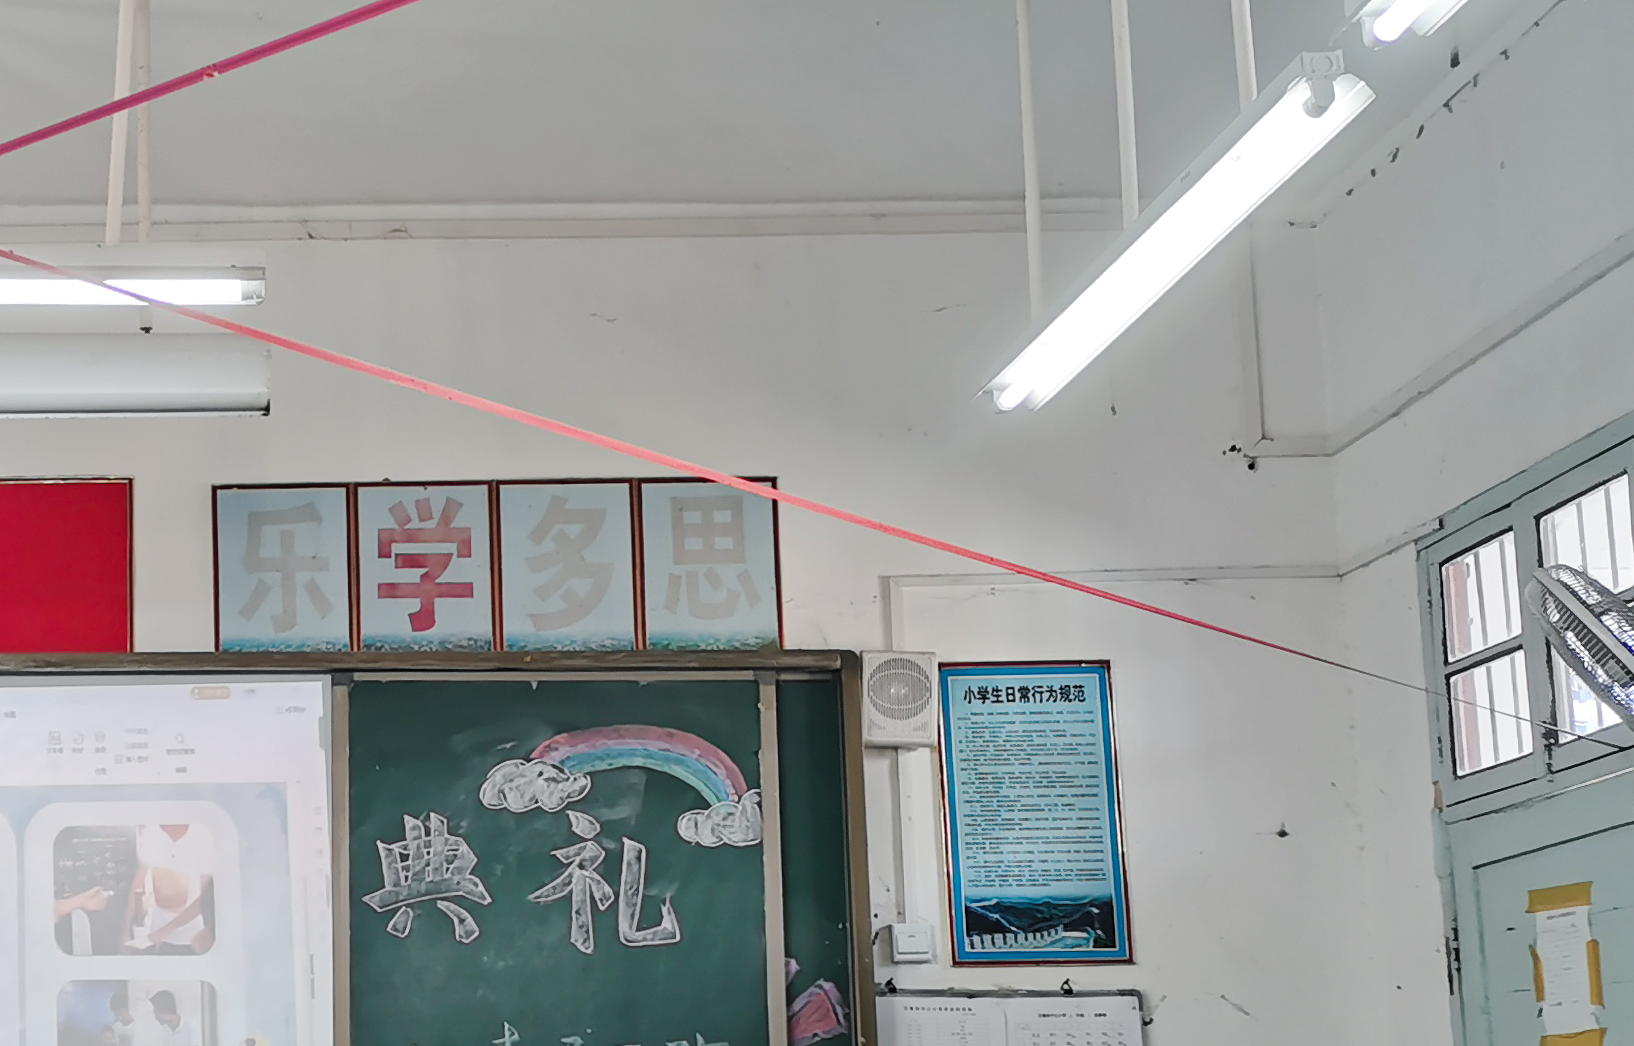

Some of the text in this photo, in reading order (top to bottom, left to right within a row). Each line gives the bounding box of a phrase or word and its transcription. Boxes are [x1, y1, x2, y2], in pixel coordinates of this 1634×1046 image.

[237, 494, 762, 634] 乐学多思
[963, 684, 1087, 704] 小学生日常行为规范
[362, 811, 681, 955] 典礼
